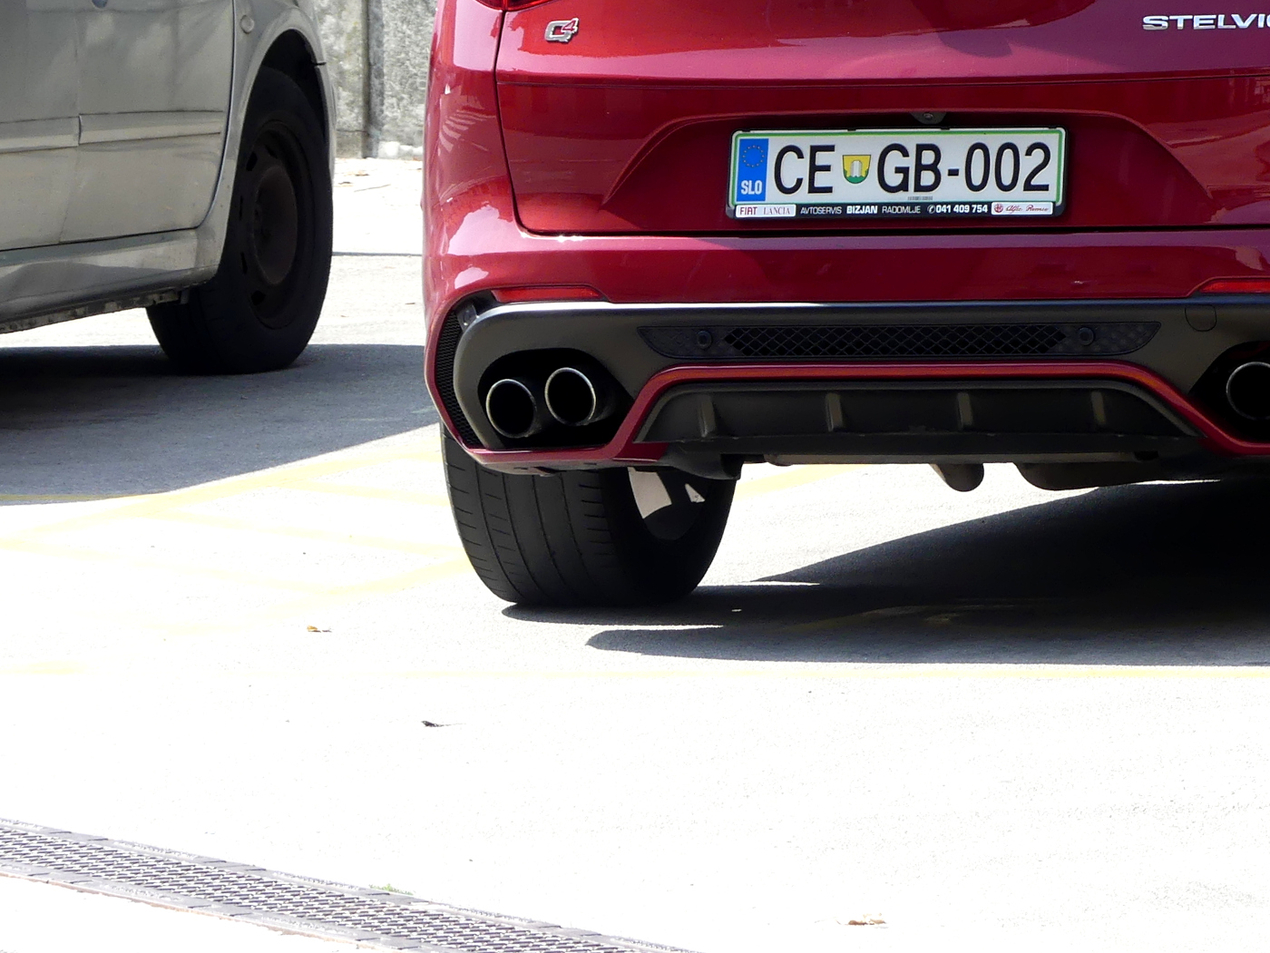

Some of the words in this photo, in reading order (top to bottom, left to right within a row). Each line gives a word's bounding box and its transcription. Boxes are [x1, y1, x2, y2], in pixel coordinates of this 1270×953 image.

[544, 17, 579, 42] Q4
[774, 144, 836, 195] CE
[877, 141, 1052, 194] GB-002
[740, 179, 763, 195] SLO
[739, 206, 758, 216] FIAT
[763, 206, 791, 215] LANCIA
[800, 206, 843, 215] AVTOSERVIS
[846, 205, 878, 214] BIZJAN
[881, 205, 921, 214] RADOMLJE
[935, 204, 951, 213] 041
[952, 204, 970, 213] 409
[971, 204, 989, 213] 754
